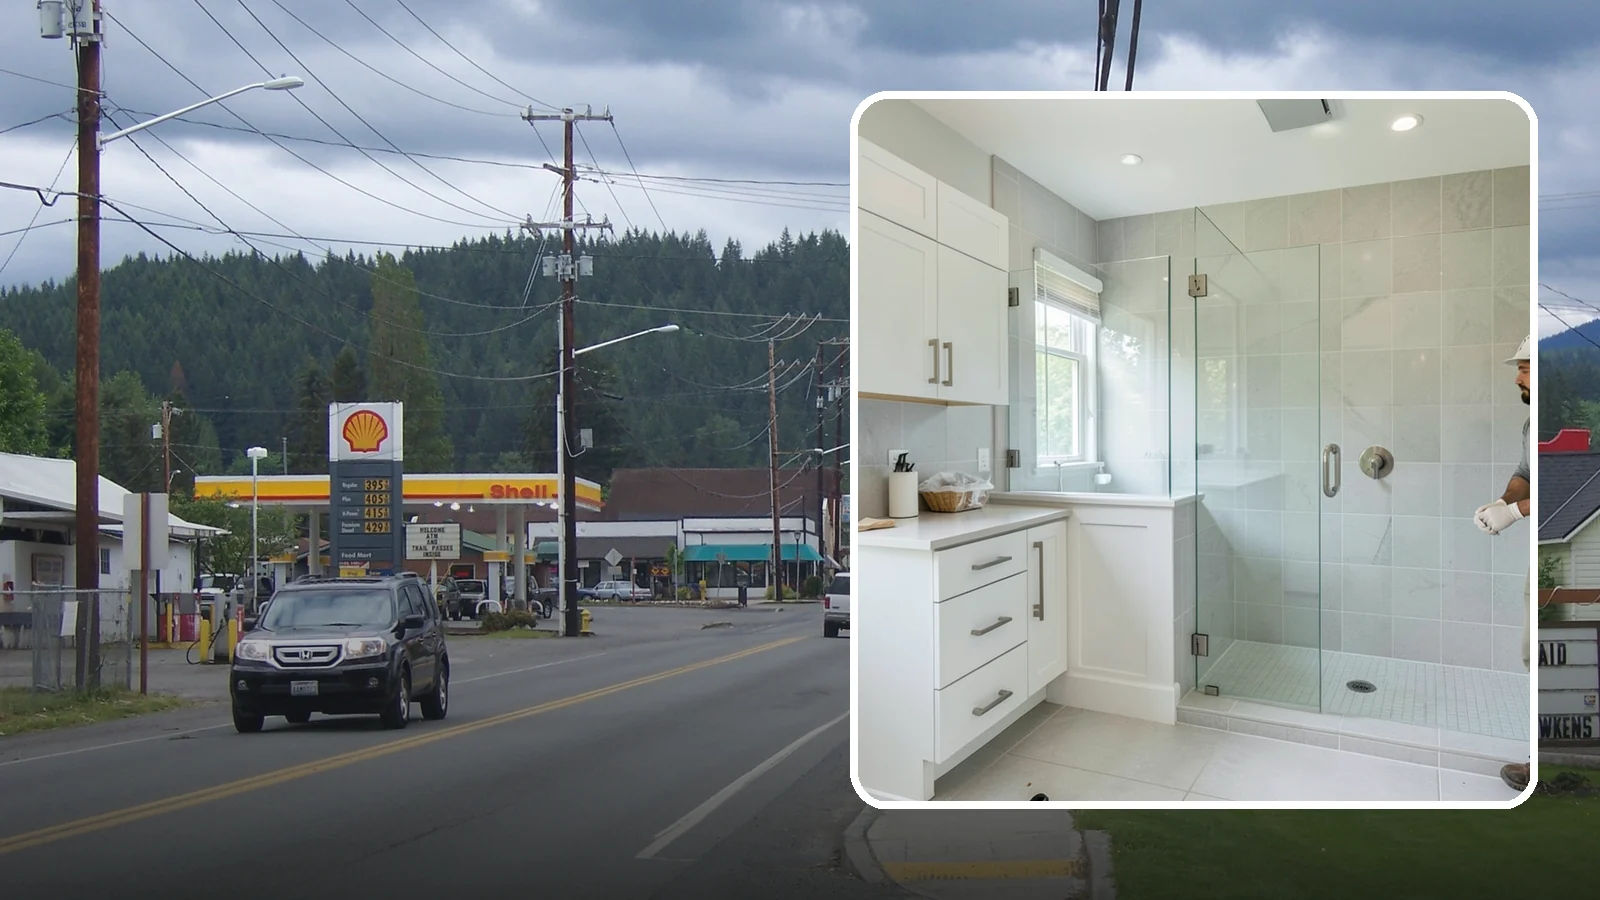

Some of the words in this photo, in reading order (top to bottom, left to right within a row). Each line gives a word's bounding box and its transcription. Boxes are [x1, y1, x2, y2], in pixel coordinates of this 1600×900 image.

[365, 480, 384, 490] 395
[490, 484, 547, 499] Shell
[365, 494, 384, 504] 405
[365, 508, 384, 518] 415
[365, 522, 384, 533] 429
